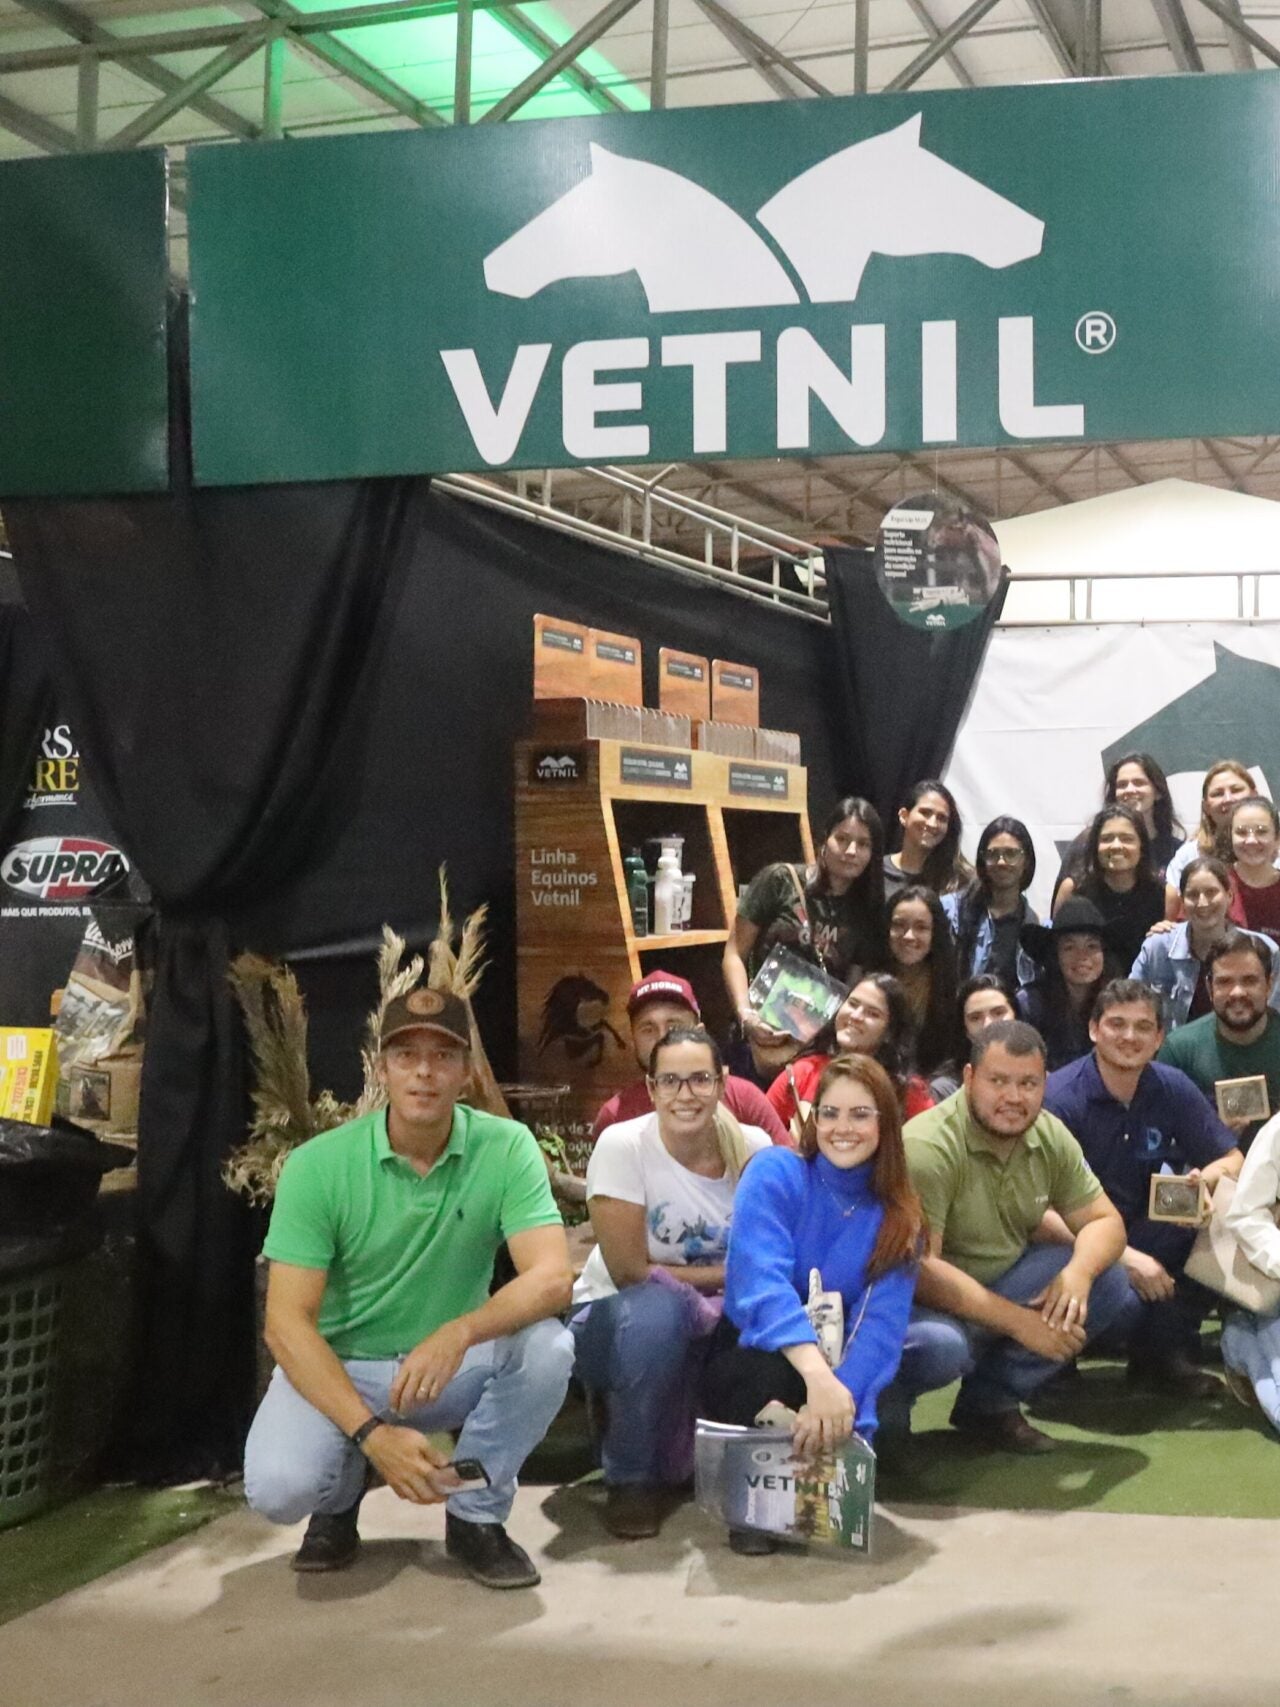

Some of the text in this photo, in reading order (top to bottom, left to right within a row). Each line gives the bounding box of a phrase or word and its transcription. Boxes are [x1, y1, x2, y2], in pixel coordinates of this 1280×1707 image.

[440, 315, 1085, 466] VETNIL
[536, 766, 579, 778] VETNIL
[531, 848, 576, 864] Linha
[6, 850, 123, 886] SUPRA
[531, 869, 598, 888] Equinos
[531, 889, 580, 906] Vetnil
